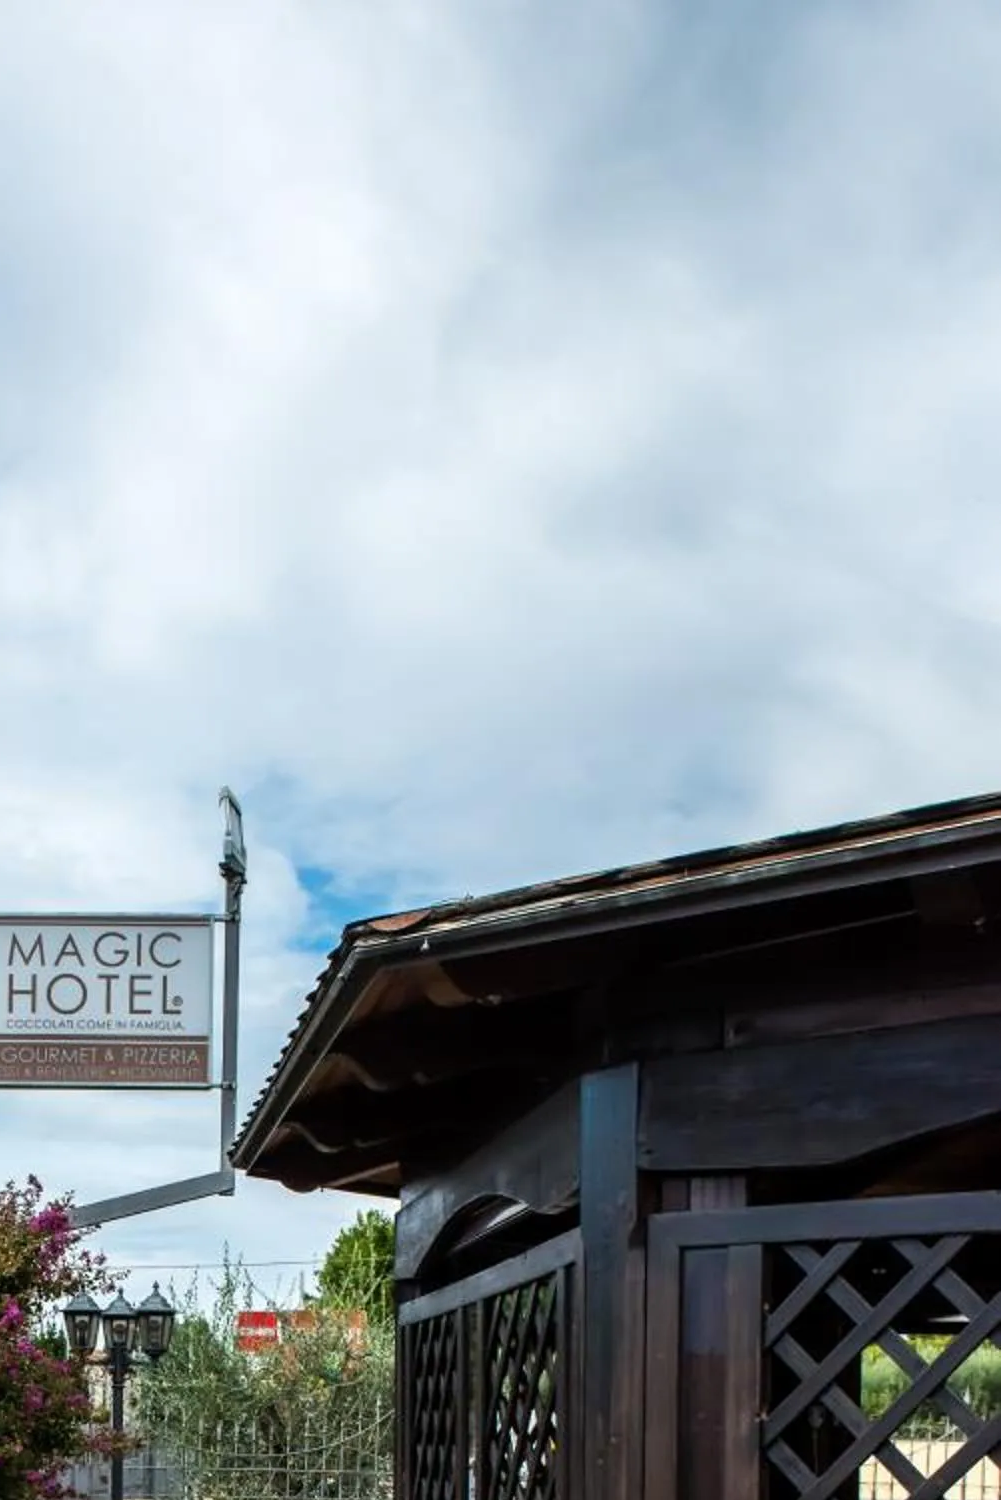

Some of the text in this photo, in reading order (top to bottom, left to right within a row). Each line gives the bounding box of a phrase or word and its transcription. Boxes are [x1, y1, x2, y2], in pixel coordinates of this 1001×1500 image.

[7, 932, 182, 968] MAGIC
[8, 973, 183, 1014] HOTEL
[76, 1019, 112, 1030] COME
[115, 1020, 127, 1030] IN
[0, 1047, 97, 1063] GOURMET
[104, 1048, 114, 1062] &
[123, 1047, 200, 1064] PIZZERIA
